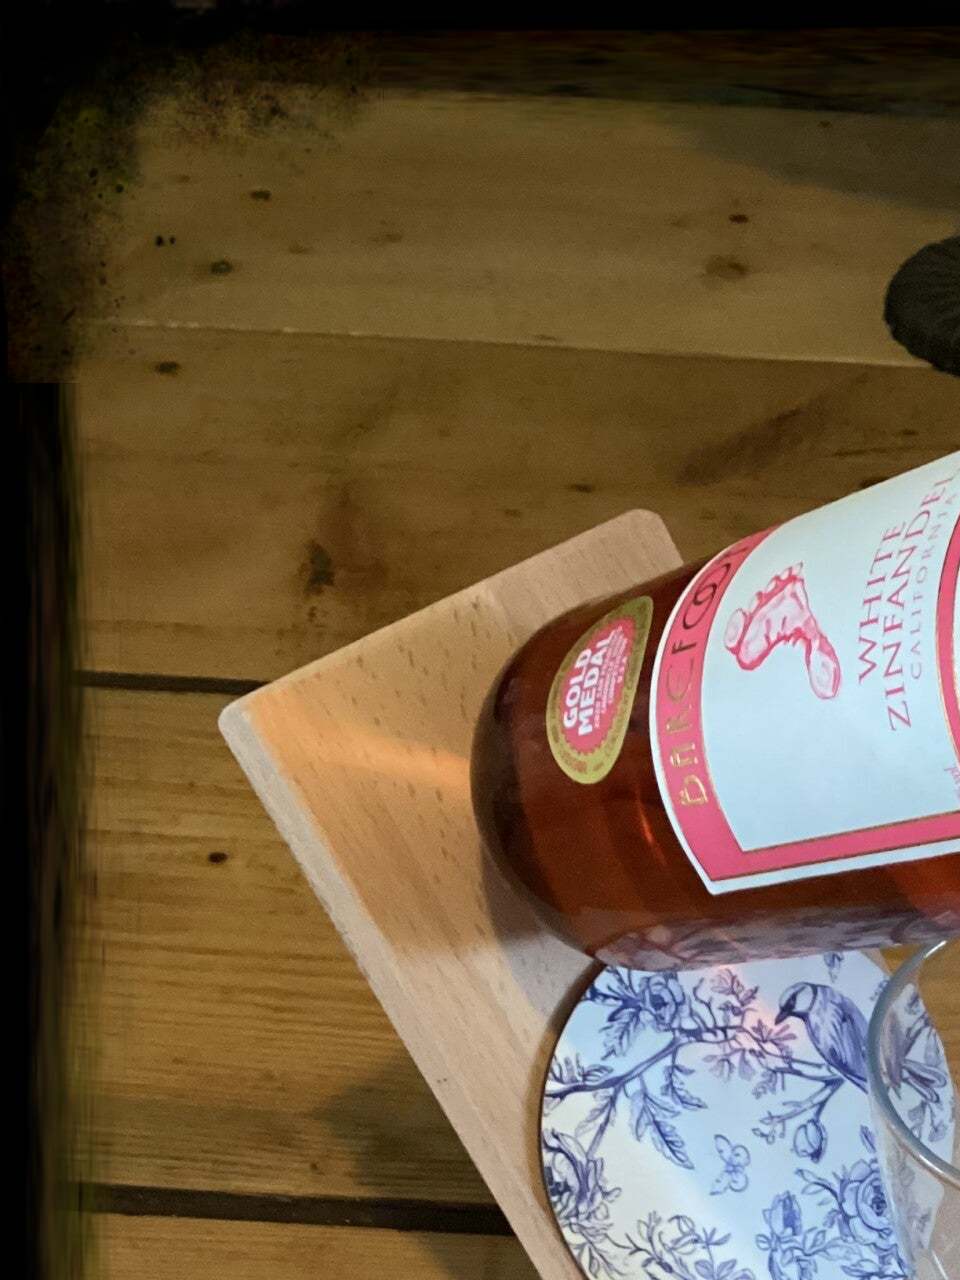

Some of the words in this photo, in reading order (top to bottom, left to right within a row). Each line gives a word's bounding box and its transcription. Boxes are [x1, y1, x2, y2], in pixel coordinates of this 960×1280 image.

[858, 521, 906, 685] WHITE
[883, 468, 960, 732] ZINFANDEL
[910, 493, 957, 680] CALIFORNIA
[563, 648, 591, 729] GOLD
[578, 628, 618, 736] MEDAL
